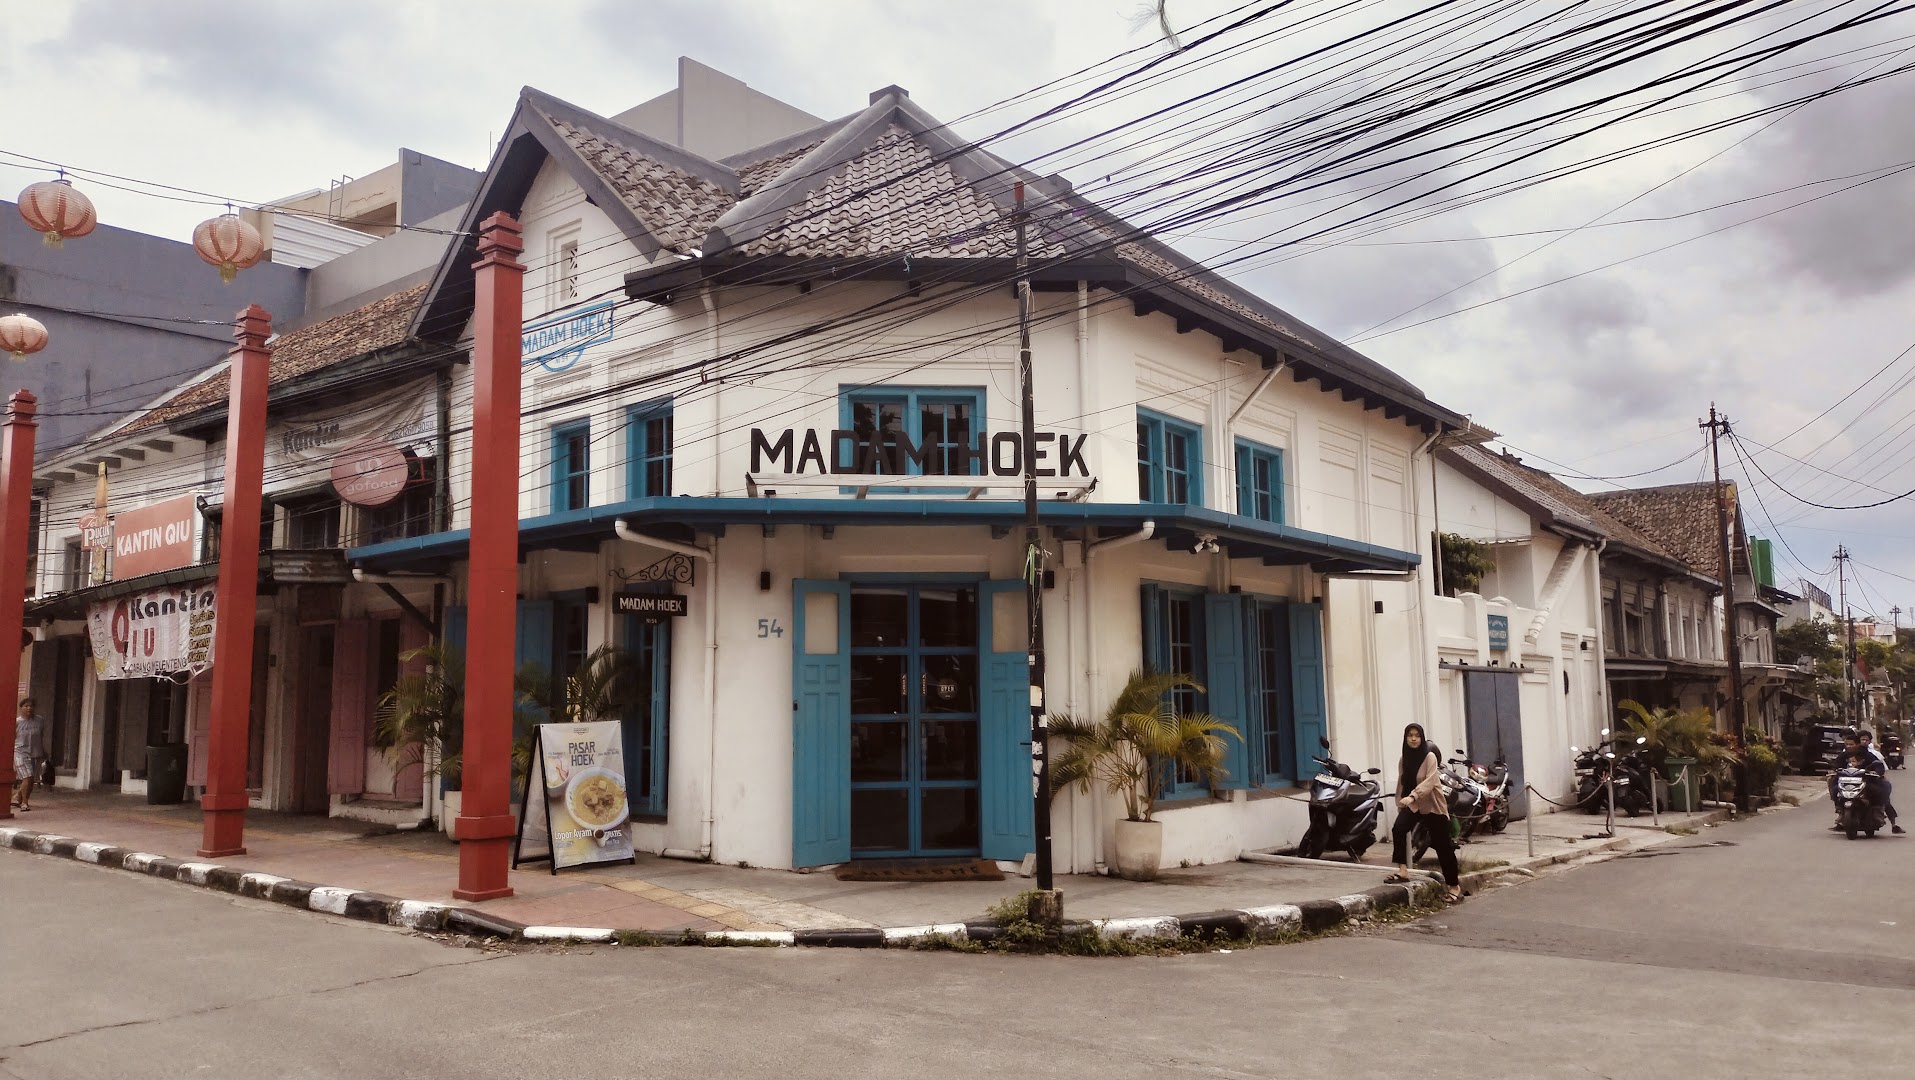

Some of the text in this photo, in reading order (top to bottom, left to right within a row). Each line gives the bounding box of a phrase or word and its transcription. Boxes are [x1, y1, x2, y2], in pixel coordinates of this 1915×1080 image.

[522, 313, 605, 354] MADAM HOEK
[750, 427, 1090, 477] MADAM HOEK
[347, 479, 399, 495] gofood
[116, 519, 190, 557] KANTIN QIU
[131, 589, 215, 621] Kantin
[620, 598, 682, 612] MADAM HOEK
[757, 618, 784, 638] 54
[568, 741, 596, 754] PASAR
[571, 754, 595, 766] HOEK
[573, 828, 593, 840] Ayam
[861, 866, 980, 876] WELCOME
